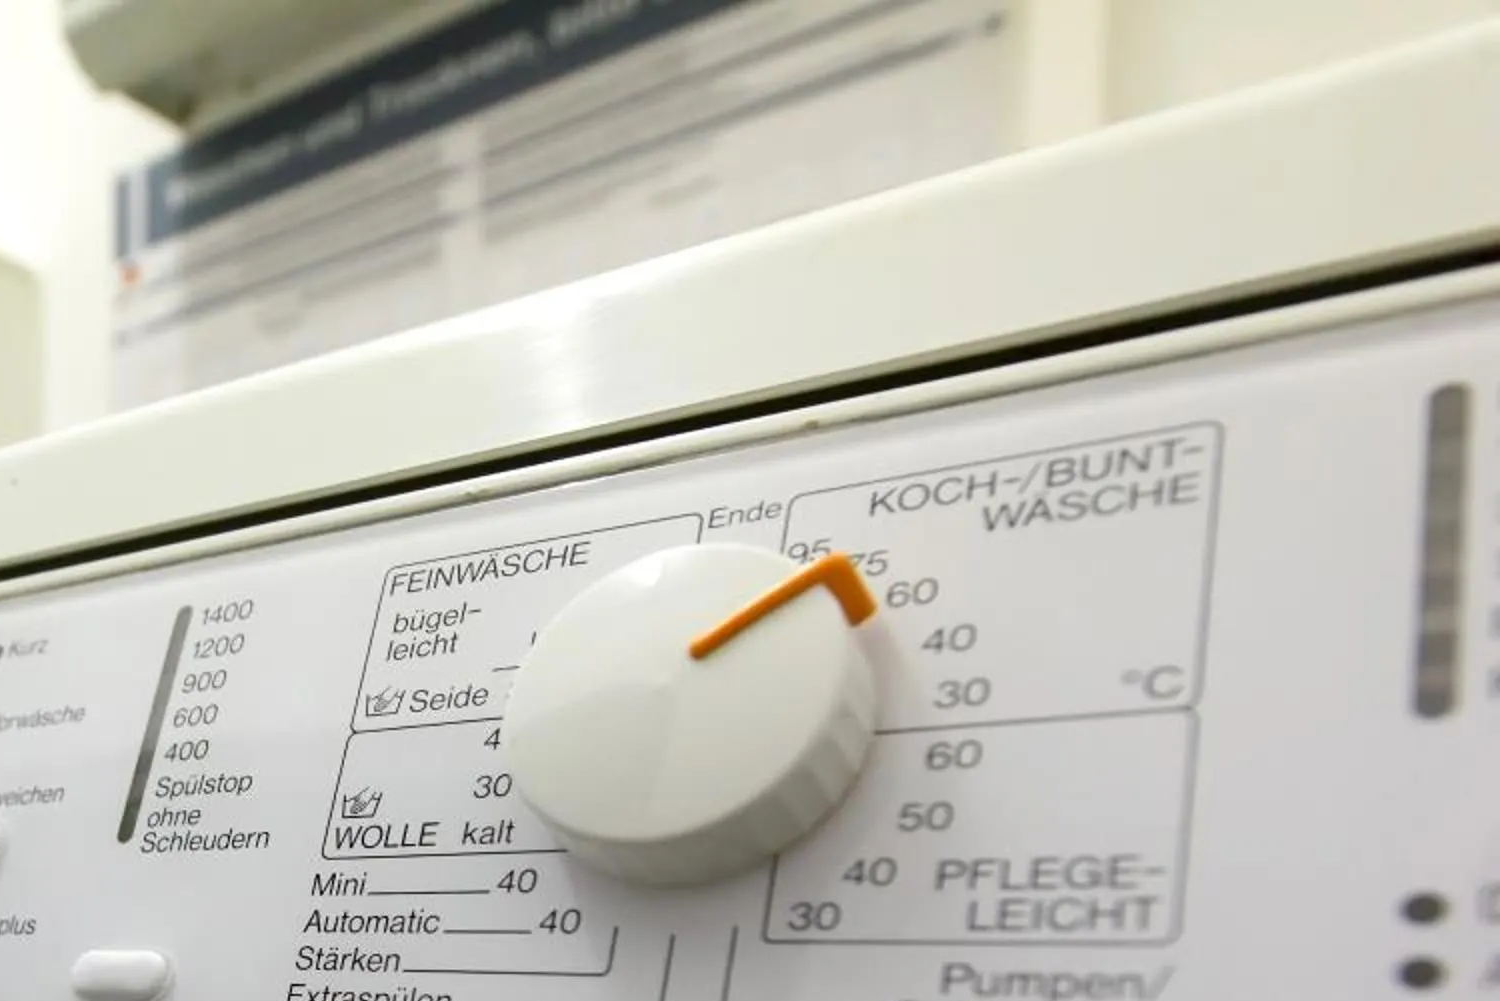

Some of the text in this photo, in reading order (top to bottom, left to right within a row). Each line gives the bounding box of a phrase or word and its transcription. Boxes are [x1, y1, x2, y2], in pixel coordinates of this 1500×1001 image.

[868, 437, 1204, 518] KOCH-/BUNT-
[707, 499, 782, 530] Ende
[982, 472, 1201, 532] WÄSCHE
[389, 541, 592, 596] FEINWÄSCHE
[886, 577, 939, 608] 60
[201, 600, 253, 625] 1400
[393, 602, 481, 637] bügel-
[8, 638, 49, 657] Kurz
[193, 634, 245, 659] 1200
[386, 631, 460, 662] leicht
[921, 622, 978, 652] 40
[182, 669, 226, 694] 900
[932, 677, 991, 710] 30
[409, 682, 489, 712] Seide
[173, 704, 219, 728] 600
[164, 739, 209, 762] 400
[484, 728, 501, 750] 4
[925, 739, 983, 770] 60
[154, 772, 253, 799] Spülstop
[473, 774, 513, 799] 30
[147, 807, 201, 829] ohne
[897, 801, 955, 832] 50
[140, 828, 270, 854] Schleudern
[334, 818, 516, 849] WOLLE kalt
[311, 868, 538, 897] Mini 40
[842, 854, 1168, 891] 40 PFLEGE-
[303, 908, 582, 935] Automatic 40
[787, 897, 1161, 932] 30 LEICHT
[295, 946, 401, 973] Stärken
[939, 962, 1176, 1001] Pumpen/
